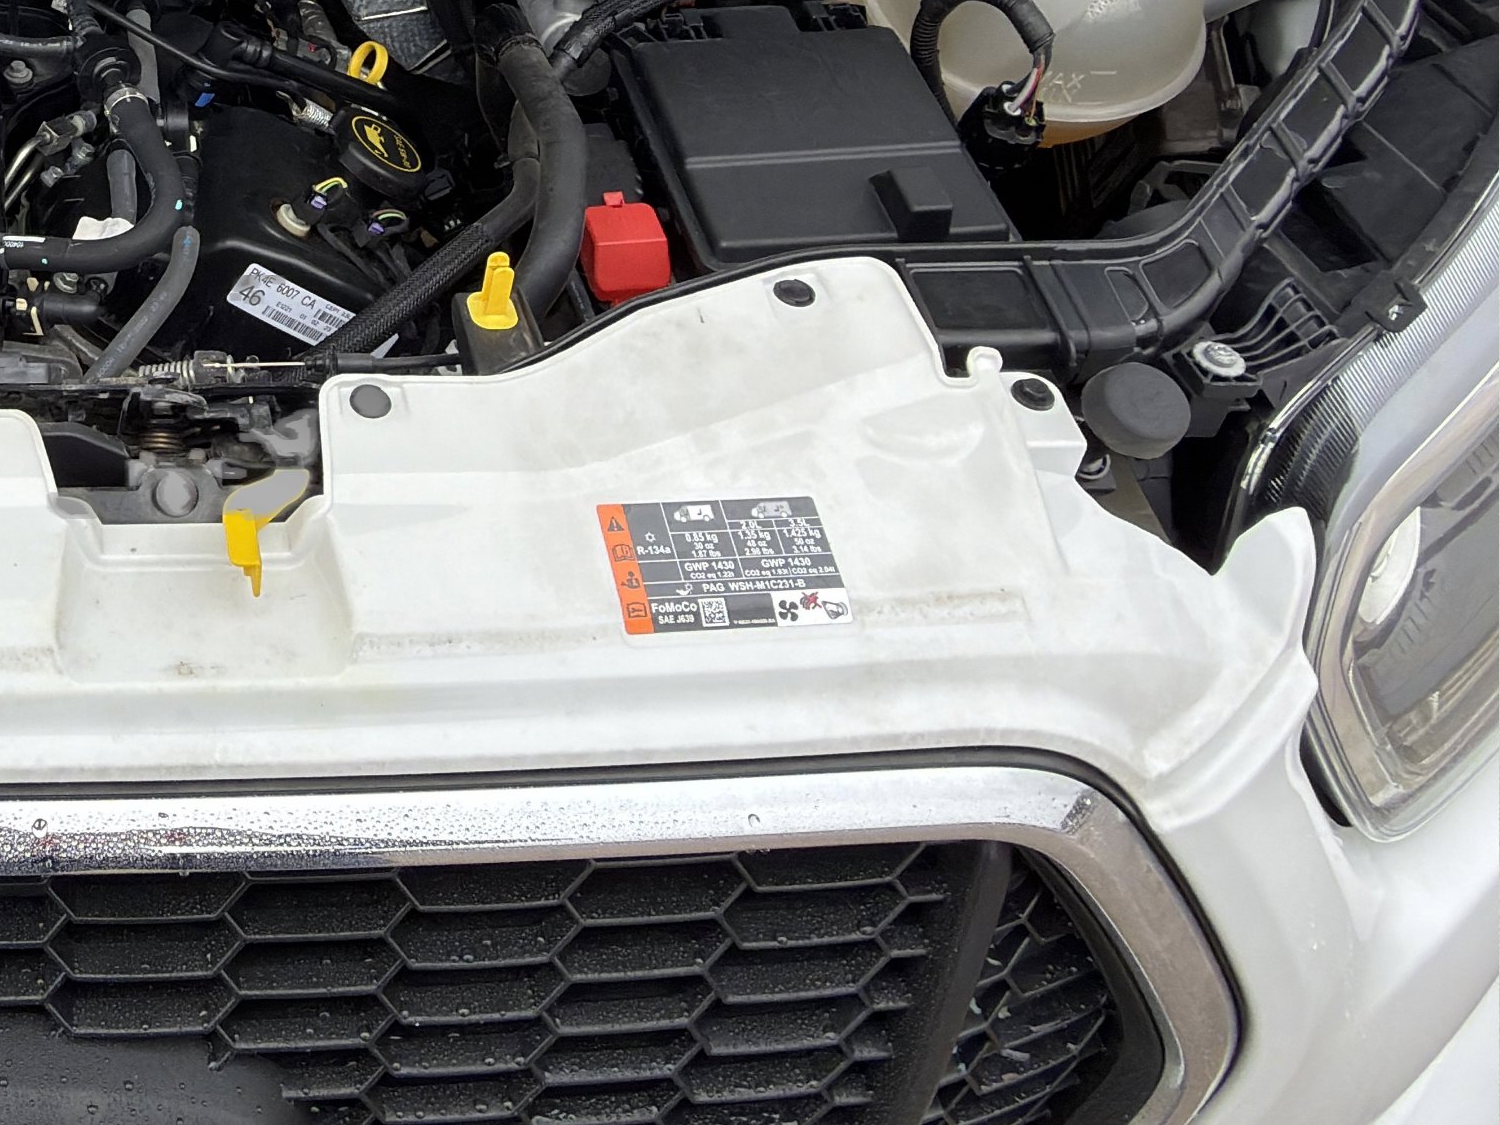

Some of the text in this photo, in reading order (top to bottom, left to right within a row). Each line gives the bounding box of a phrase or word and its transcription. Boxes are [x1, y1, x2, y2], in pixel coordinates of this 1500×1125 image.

[250, 267, 317, 310] PK4E 6007 CA
[239, 285, 265, 306] 46
[740, 520, 762, 529] 2.0L
[789, 518, 810, 527] 3.5L
[685, 532, 718, 543] 0.85 kg
[738, 530, 771, 540] 1.35 kg
[783, 528, 821, 538] 1.425 kg
[637, 546, 671, 555] R-134a
[694, 542, 703, 550] 30
[762, 547, 774, 555] lbs
[685, 561, 734, 571] GWP 1430
[761, 557, 811, 567] GWP 1430
[702, 579, 806, 592] PAG WSH-M1C231-B
[651, 601, 697, 613] FoMoCo
[658, 614, 694, 624] SAE J639
